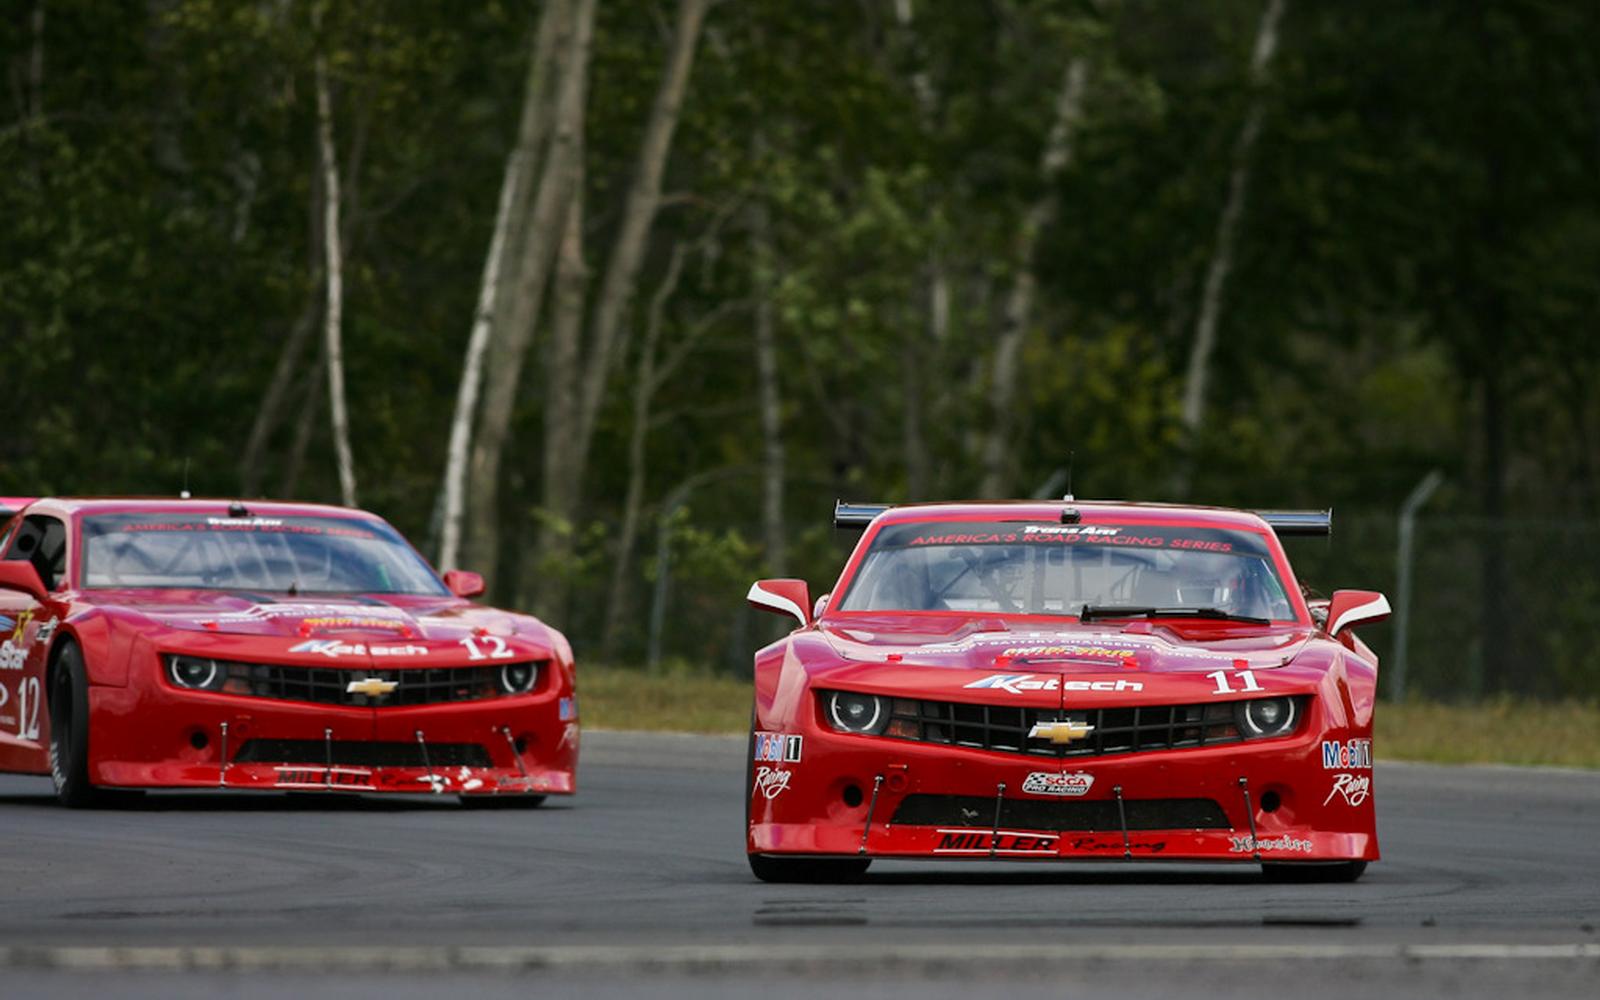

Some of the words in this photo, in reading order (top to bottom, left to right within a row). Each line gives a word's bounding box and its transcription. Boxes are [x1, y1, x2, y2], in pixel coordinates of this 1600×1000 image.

[910, 533, 1017, 546] AMERICA'S
[1023, 533, 1080, 543] ROAD
[1086, 535, 1164, 547] RACING
[1170, 538, 1233, 552] SERIES
[459, 636, 514, 660] 12
[964, 674, 1144, 695] Katech
[1206, 670, 1265, 695] 11
[17, 676, 39, 740] 12
[1046, 777, 1088, 786] SCCA
[939, 833, 1055, 850] MILLER
